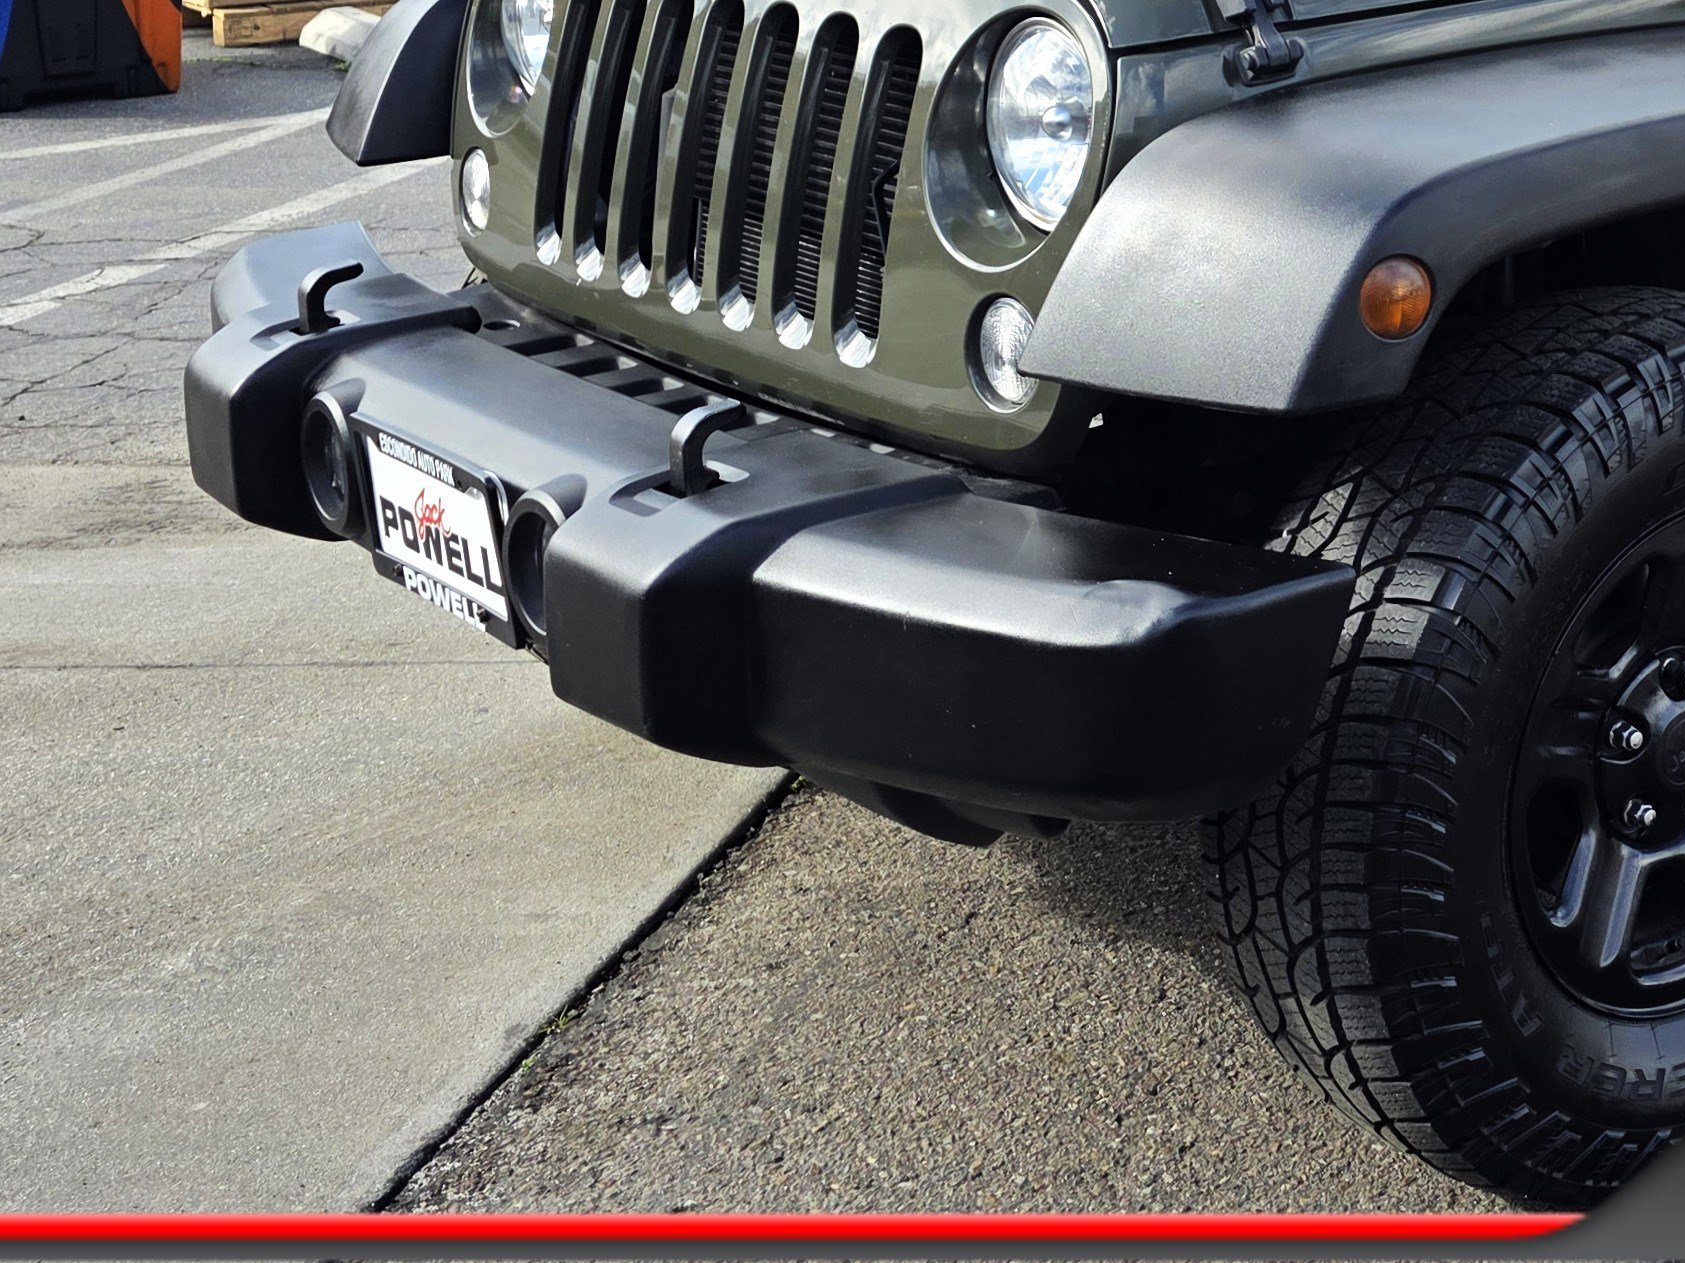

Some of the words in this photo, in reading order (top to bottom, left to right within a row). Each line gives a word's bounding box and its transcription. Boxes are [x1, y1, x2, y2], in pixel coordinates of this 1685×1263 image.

[379, 495, 504, 597] POWELL
[414, 488, 451, 541] Jack
[403, 566, 486, 632] POWELL
